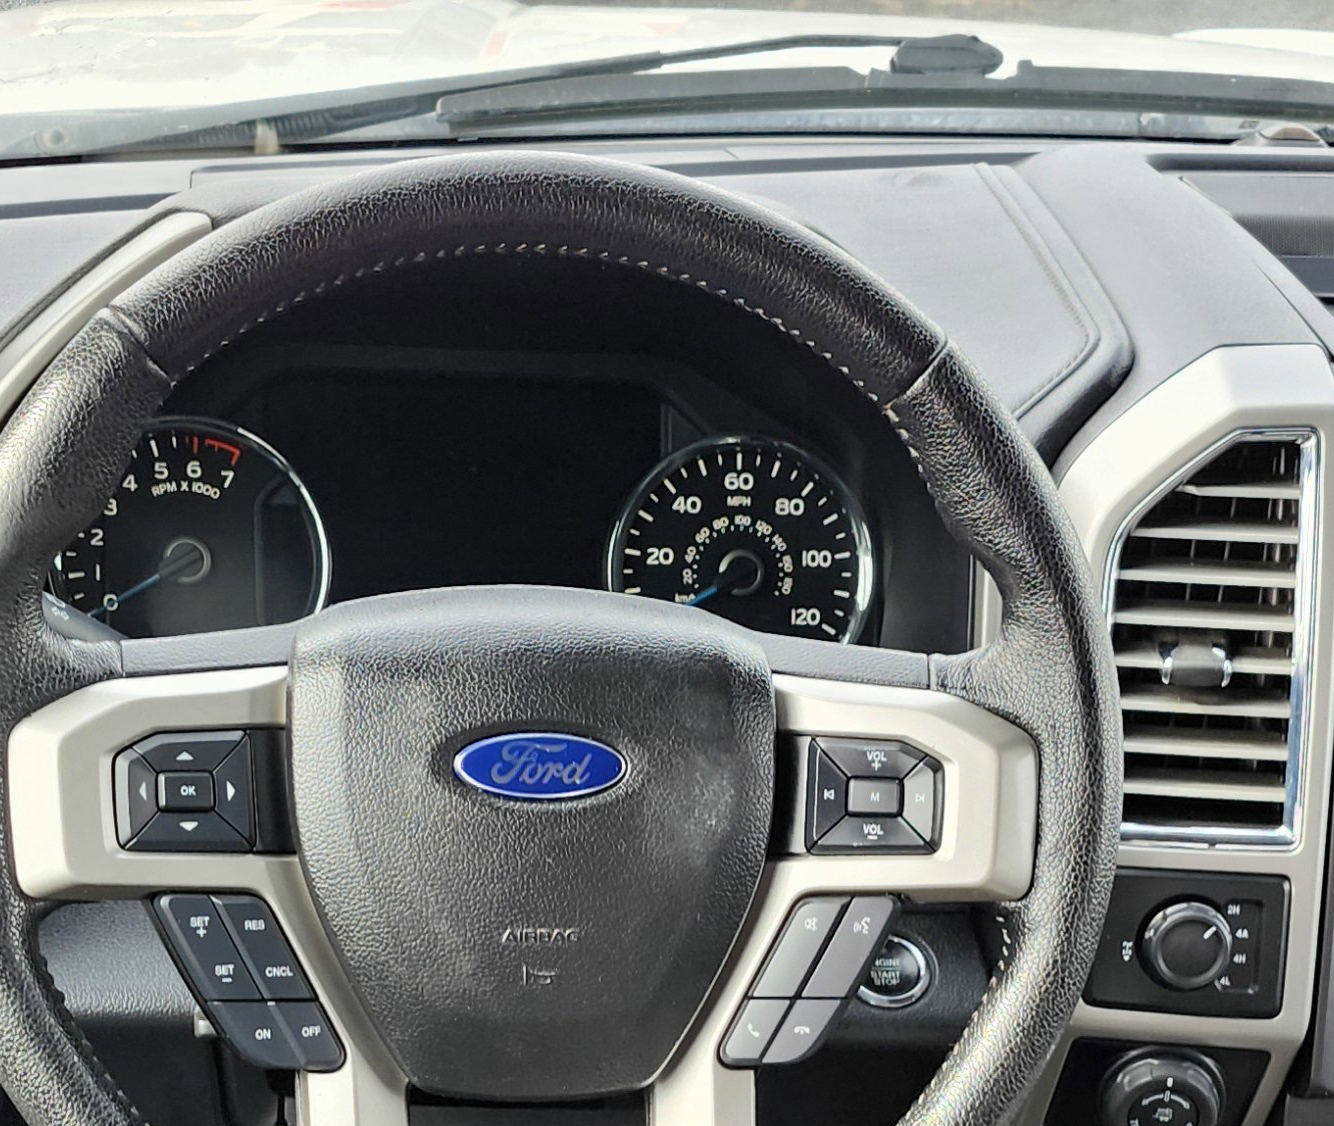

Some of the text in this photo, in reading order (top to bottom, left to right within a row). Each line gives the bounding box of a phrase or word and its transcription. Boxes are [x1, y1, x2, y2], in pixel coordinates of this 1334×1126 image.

[154, 462, 168, 479] 5
[187, 461, 202, 478] 6
[122, 474, 138, 492] 4
[220, 470, 234, 488] 7
[724, 472, 754, 491] 60
[151, 481, 220, 499] RPM X 1000
[103, 498, 118, 516] 3
[672, 496, 702, 514] 40
[727, 496, 751, 507] MPH
[775, 498, 805, 516] 80
[90, 530, 104, 546] 2
[695, 527, 710, 543] 60
[646, 548, 674, 566] 20
[684, 546, 697, 564] 40
[802, 550, 832, 568] 100
[682, 568, 693, 585] 20
[102, 593, 118, 611] 0
[791, 608, 821, 626] 120
[490, 740, 592, 785] Ford
[867, 750, 887, 762] VOL
[180, 784, 197, 797] OK
[870, 792, 880, 802] M
[862, 823, 884, 835] VOL
[1227, 904, 1241, 916] 2H
[190, 916, 210, 928] SET
[244, 920, 265, 931] RES
[1235, 928, 1249, 940] 4A
[1233, 953, 1246, 965] 4H
[214, 964, 235, 976] SET
[265, 966, 293, 978] CNCL
[1219, 976, 1231, 987] 4L
[254, 1028, 272, 1041] ON
[301, 1025, 321, 1038] OFF
